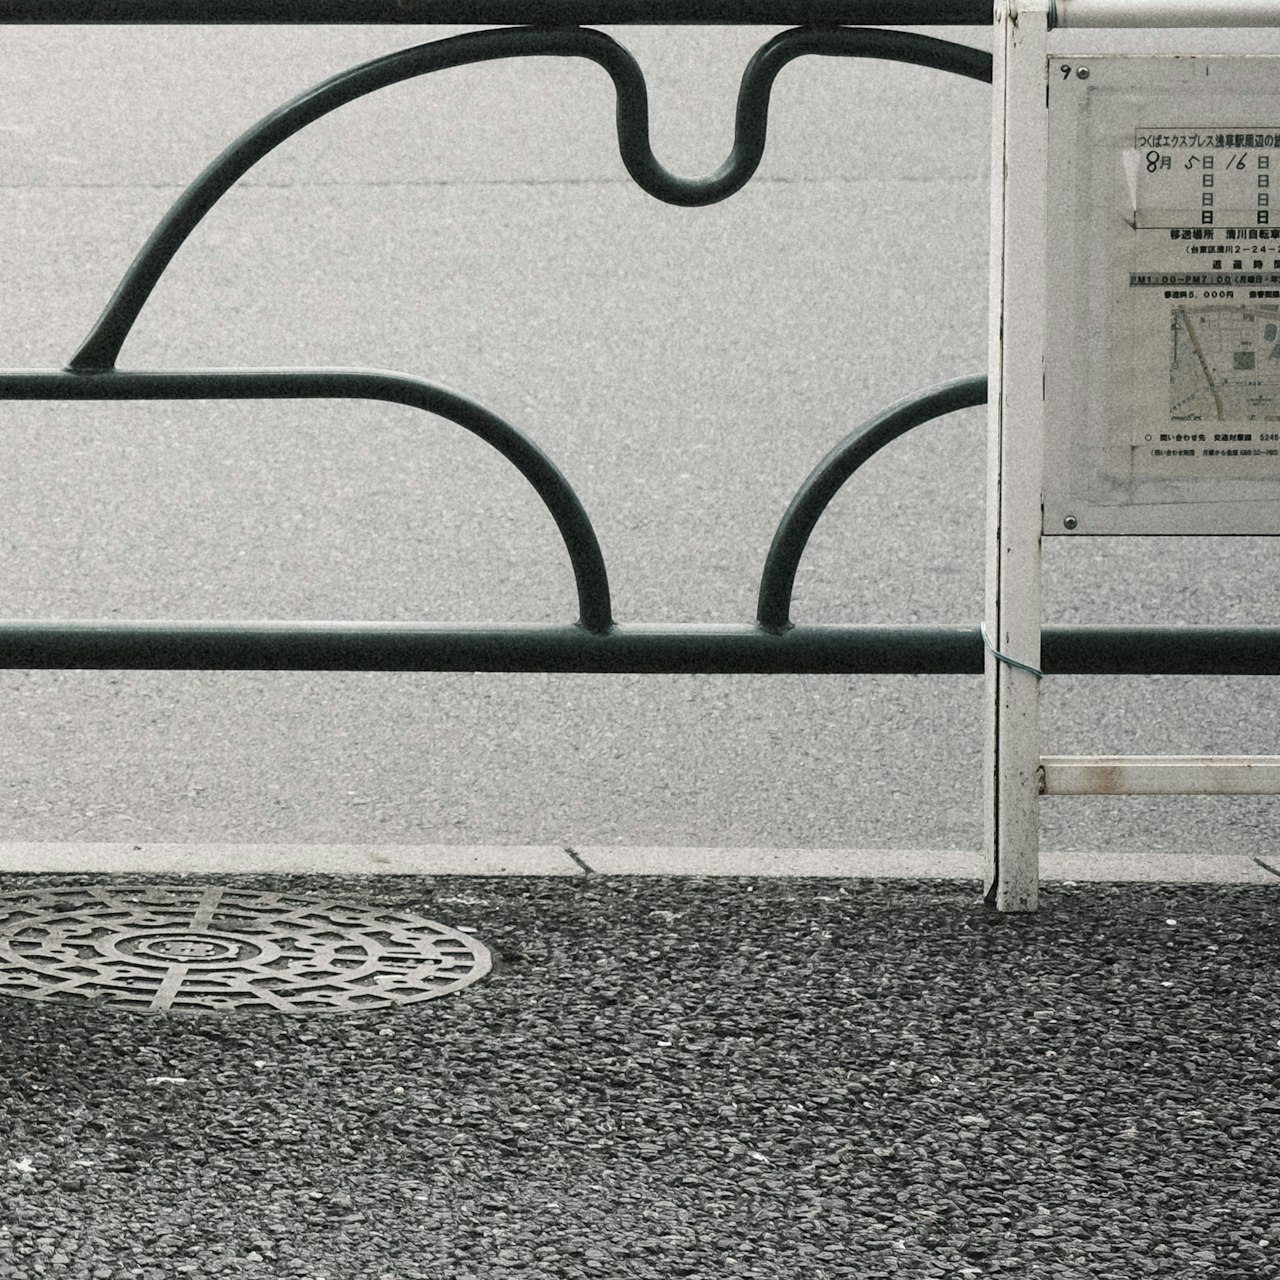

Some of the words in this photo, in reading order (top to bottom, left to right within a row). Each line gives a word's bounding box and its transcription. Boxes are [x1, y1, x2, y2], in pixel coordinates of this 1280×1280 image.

[1060, 64, 1072, 80] 9
[1202, 174, 1214, 187] 日
[1258, 174, 1269, 188] 日
[1202, 192, 1213, 206] 日
[1258, 193, 1269, 207] 日
[1201, 210, 1213, 225] 日
[1257, 210, 1269, 225] 日
